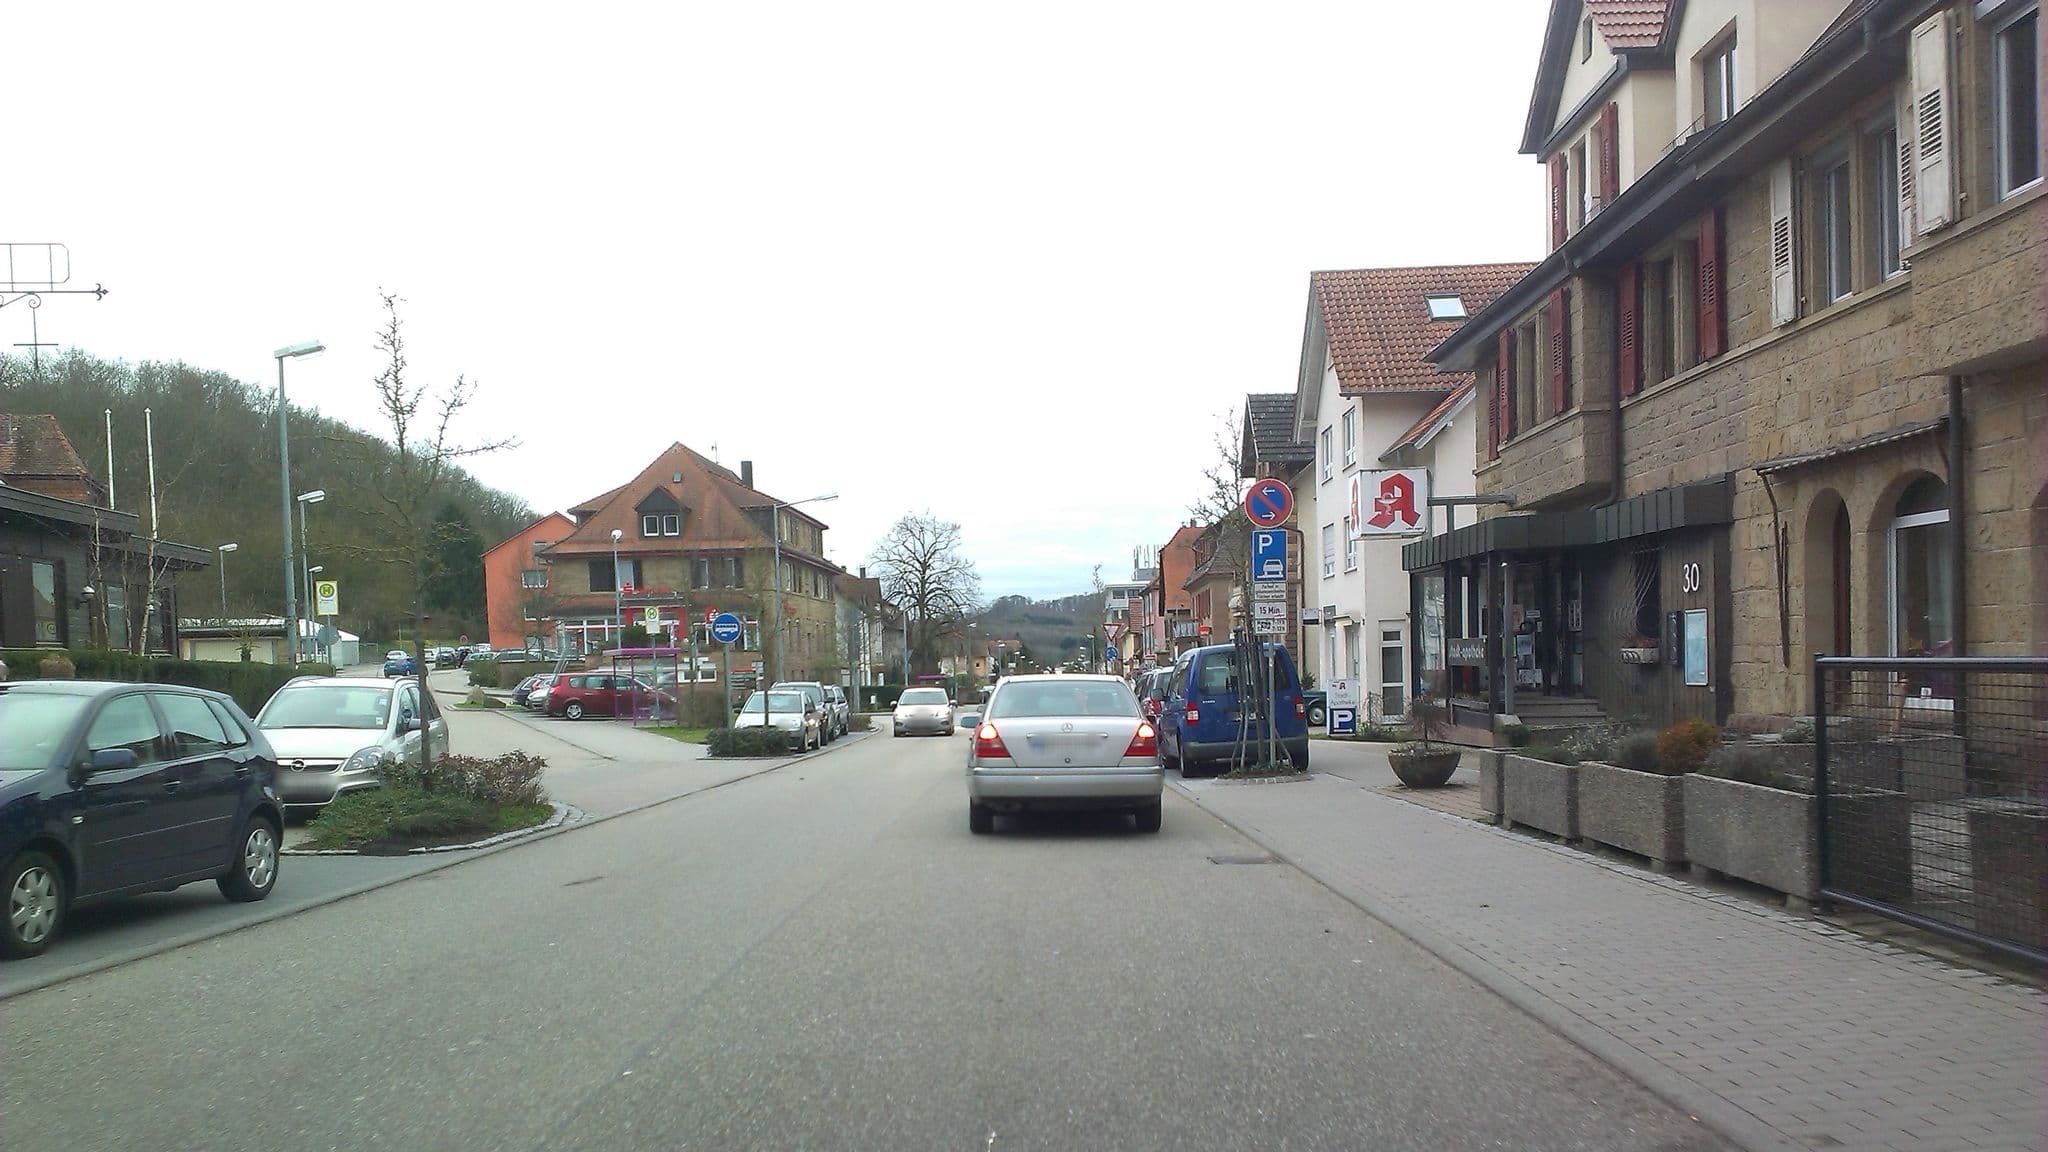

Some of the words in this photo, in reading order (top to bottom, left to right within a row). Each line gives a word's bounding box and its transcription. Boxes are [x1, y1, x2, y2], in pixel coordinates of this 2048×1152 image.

[1258, 534, 1273, 555] P
[1682, 562, 1700, 593] 30
[1259, 606, 1267, 615] 15
[1333, 710, 1353, 729] P
